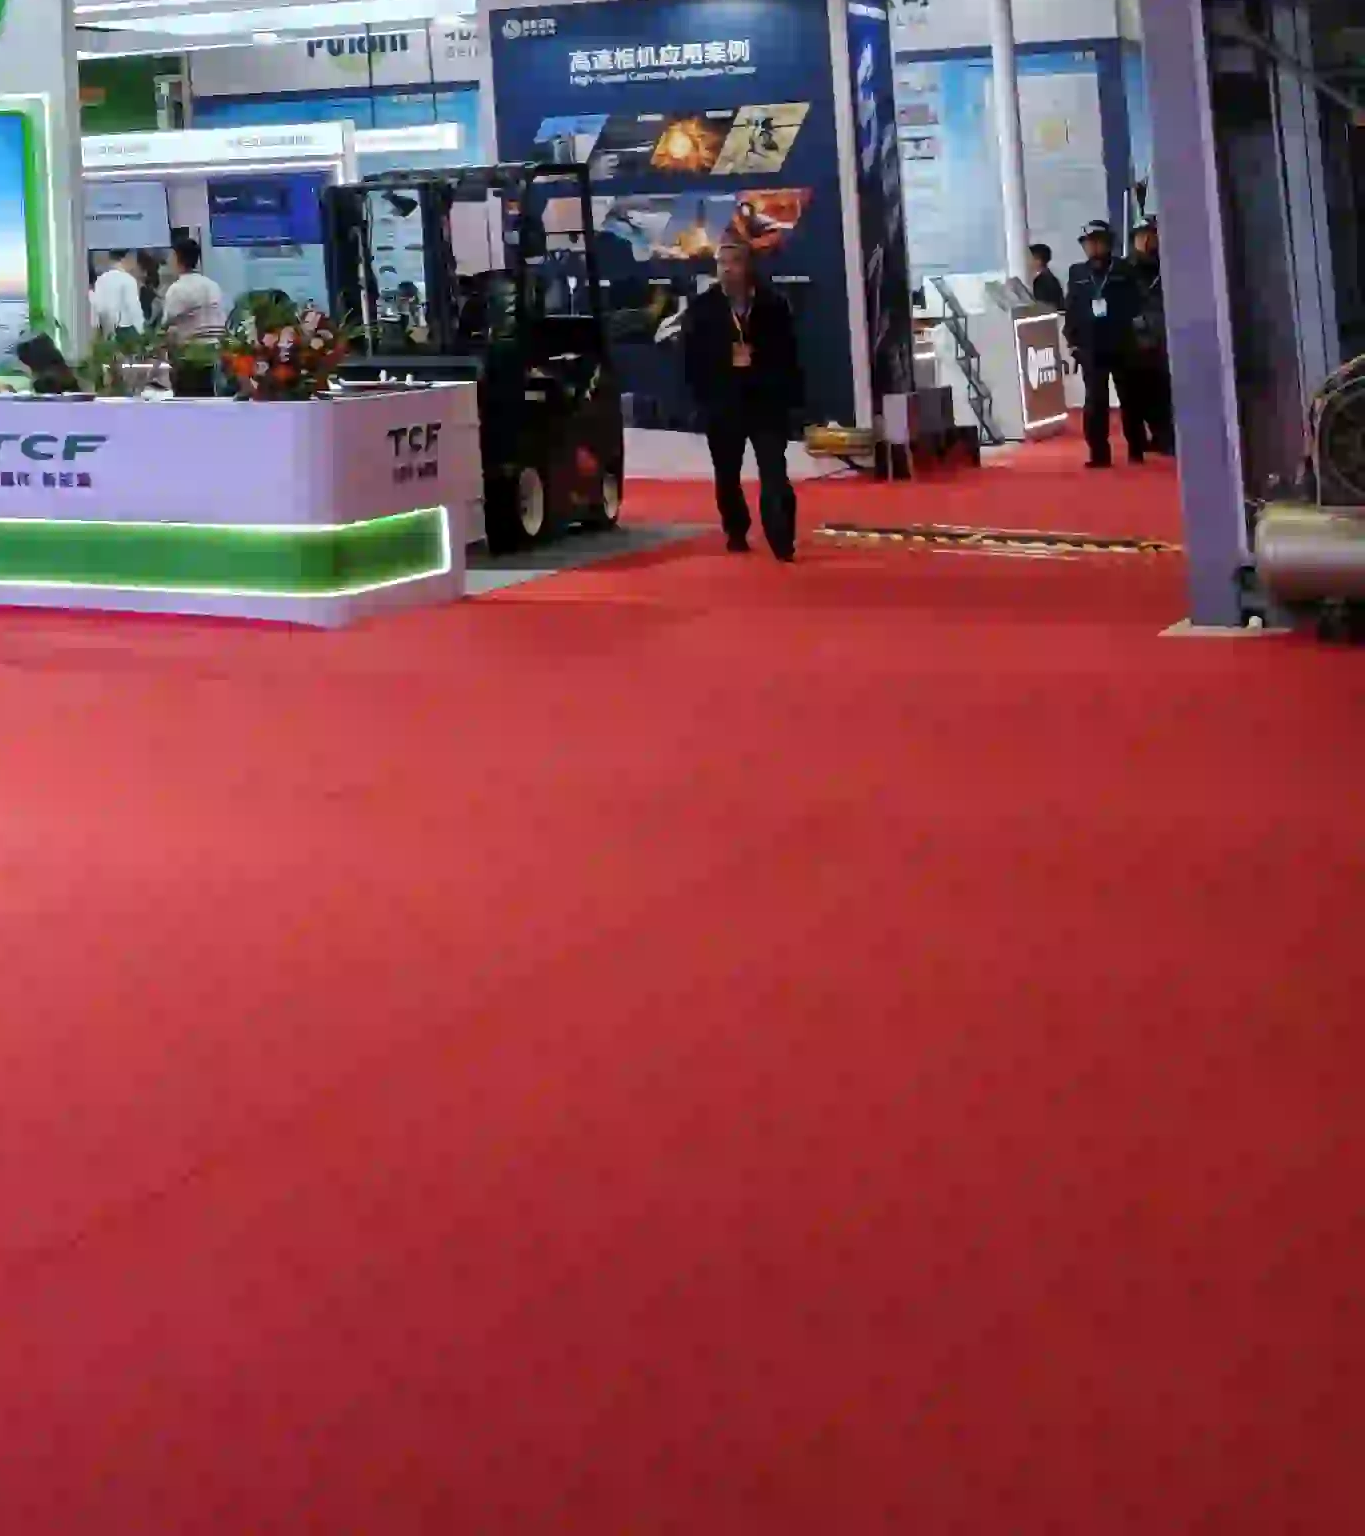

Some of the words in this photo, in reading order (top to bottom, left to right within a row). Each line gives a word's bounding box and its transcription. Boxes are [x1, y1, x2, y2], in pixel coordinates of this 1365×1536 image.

[569, 38, 751, 73] 高速相机应用案例
[386, 422, 443, 457] TCF
